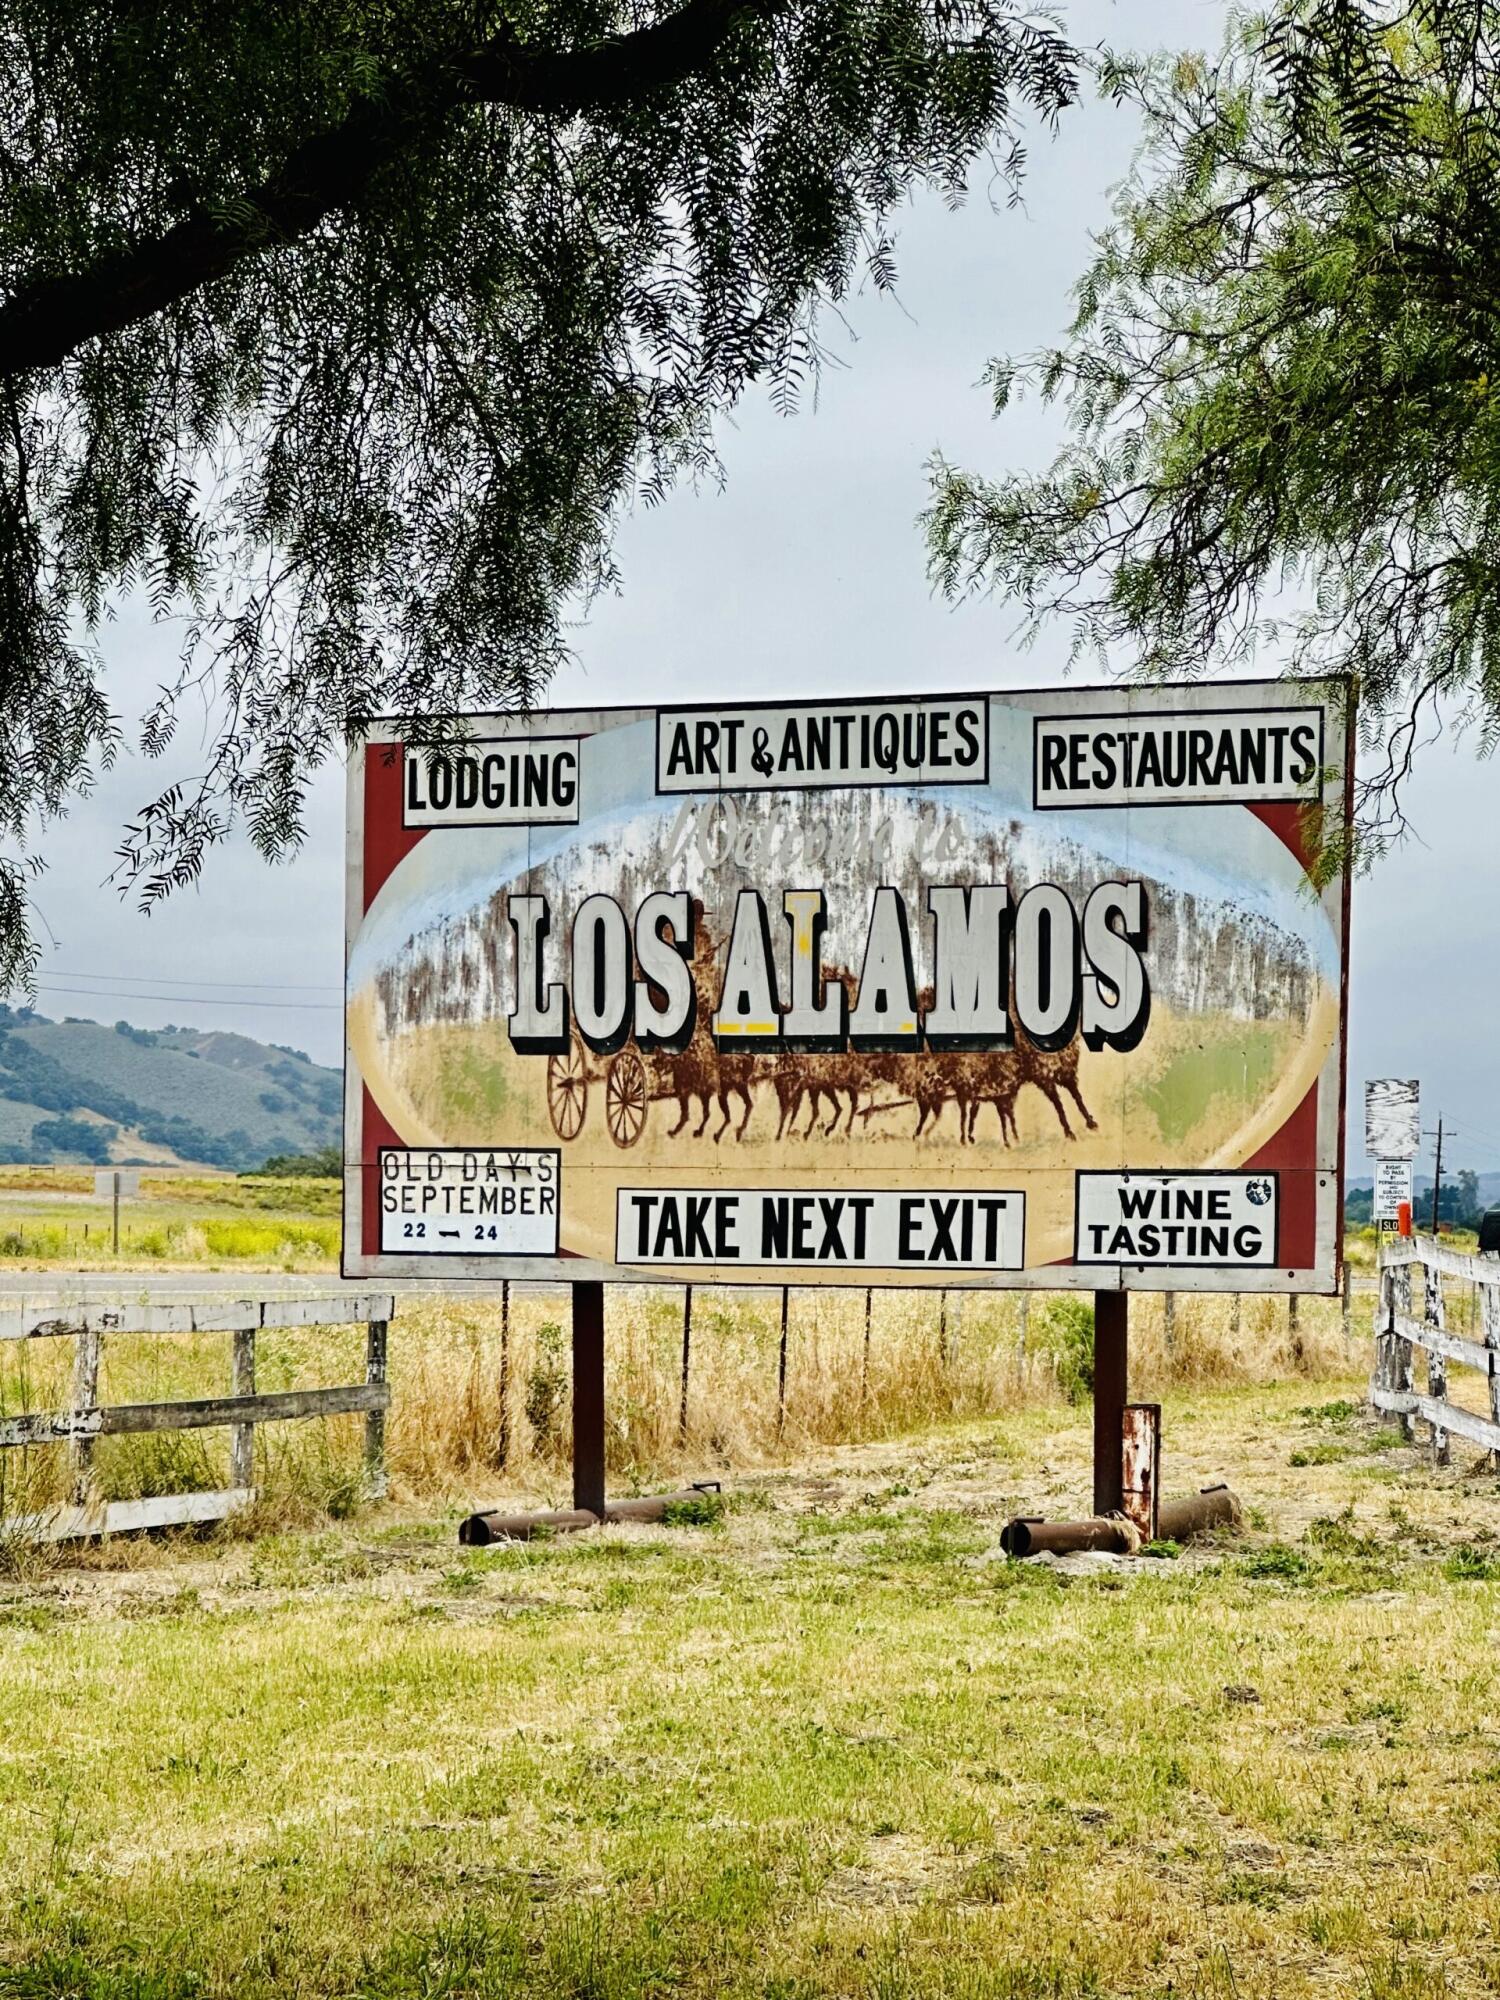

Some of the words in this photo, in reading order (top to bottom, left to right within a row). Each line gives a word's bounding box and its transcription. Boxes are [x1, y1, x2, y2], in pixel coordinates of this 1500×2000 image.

[408, 751, 577, 811] LODGING
[1041, 724, 1316, 791] RESTAURANTS
[662, 793, 895, 868] Welcome
[912, 808, 965, 863] to
[508, 891, 698, 1055] LOS
[712, 880, 1152, 1054] ALAMOS
[383, 1152, 443, 1182] OLD
[462, 1152, 553, 1183] DAYS
[383, 1184, 556, 1216] SEPTEMBER
[1117, 1188, 1232, 1220] WINE
[403, 1222, 426, 1239] 22
[474, 1223, 498, 1241] 24
[631, 1195, 740, 1259] TAKE
[762, 1196, 874, 1260] NEXT
[899, 1198, 1007, 1262] EXIT
[1087, 1224, 1263, 1258] TASTING
